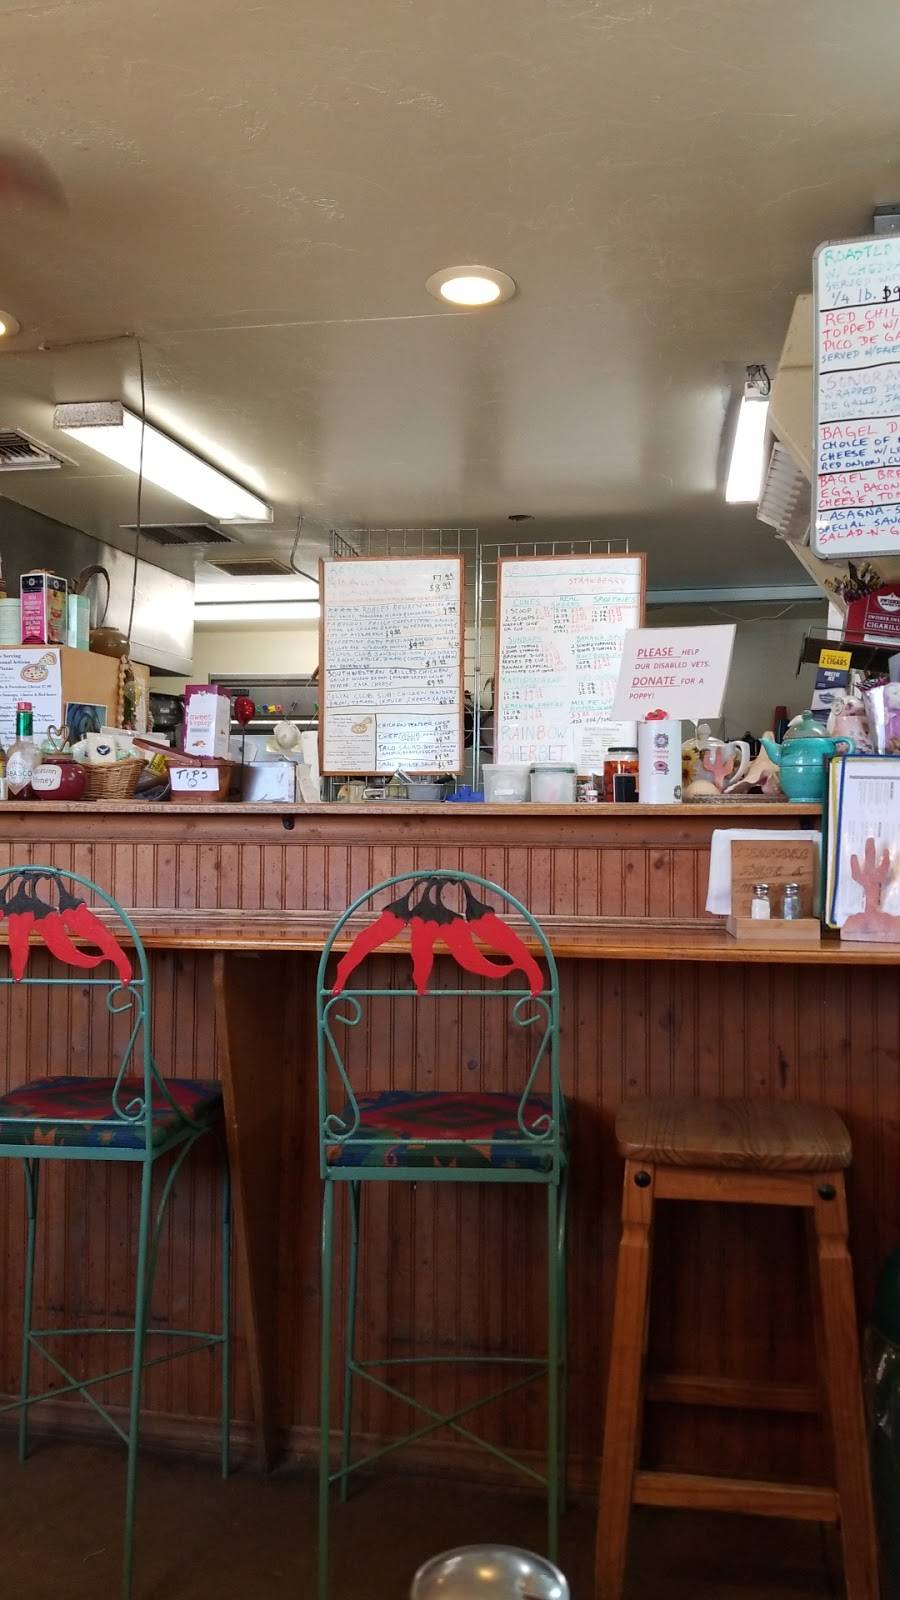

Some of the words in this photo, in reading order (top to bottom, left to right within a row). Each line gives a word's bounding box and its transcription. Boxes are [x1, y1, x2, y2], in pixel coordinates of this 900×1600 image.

[832, 290, 850, 306] 1/4
[825, 311, 856, 326] RED
[822, 320, 875, 340] TOPPED
[882, 317, 899, 331] W/
[822, 339, 853, 352] PICO
[858, 335, 879, 346] DE
[821, 350, 860, 364] SERVED
[820, 424, 878, 441] BAGEL
[822, 437, 870, 451] CHOICE
[874, 436, 891, 447] OF
[820, 448, 867, 462] CHEESE
[821, 461, 842, 471] RED
[818, 472, 867, 488] BAGEL
[820, 486, 860, 499] EGG,
[818, 495, 874, 509] CHEESE,
[819, 506, 884, 522] LASAGNA
[818, 520, 866, 535] SPECIAL
[510, 607, 533, 615] SCOOP
[636, 647, 674, 658] PLEASE
[681, 648, 700, 656] HELP
[653, 661, 688, 669] DISABLED
[821, 656, 827, 664] 2
[827, 657, 849, 667] CIGARS
[631, 676, 677, 687] DONATE
[680, 677, 696, 685] FOR
[697, 677, 705, 685] A
[628, 692, 656, 700] POPPY!
[501, 725, 568, 741] RAINBOW
[378, 744, 396, 752] TACO
[501, 744, 569, 762] SHERBET
[175, 768, 209, 781] TIPS
